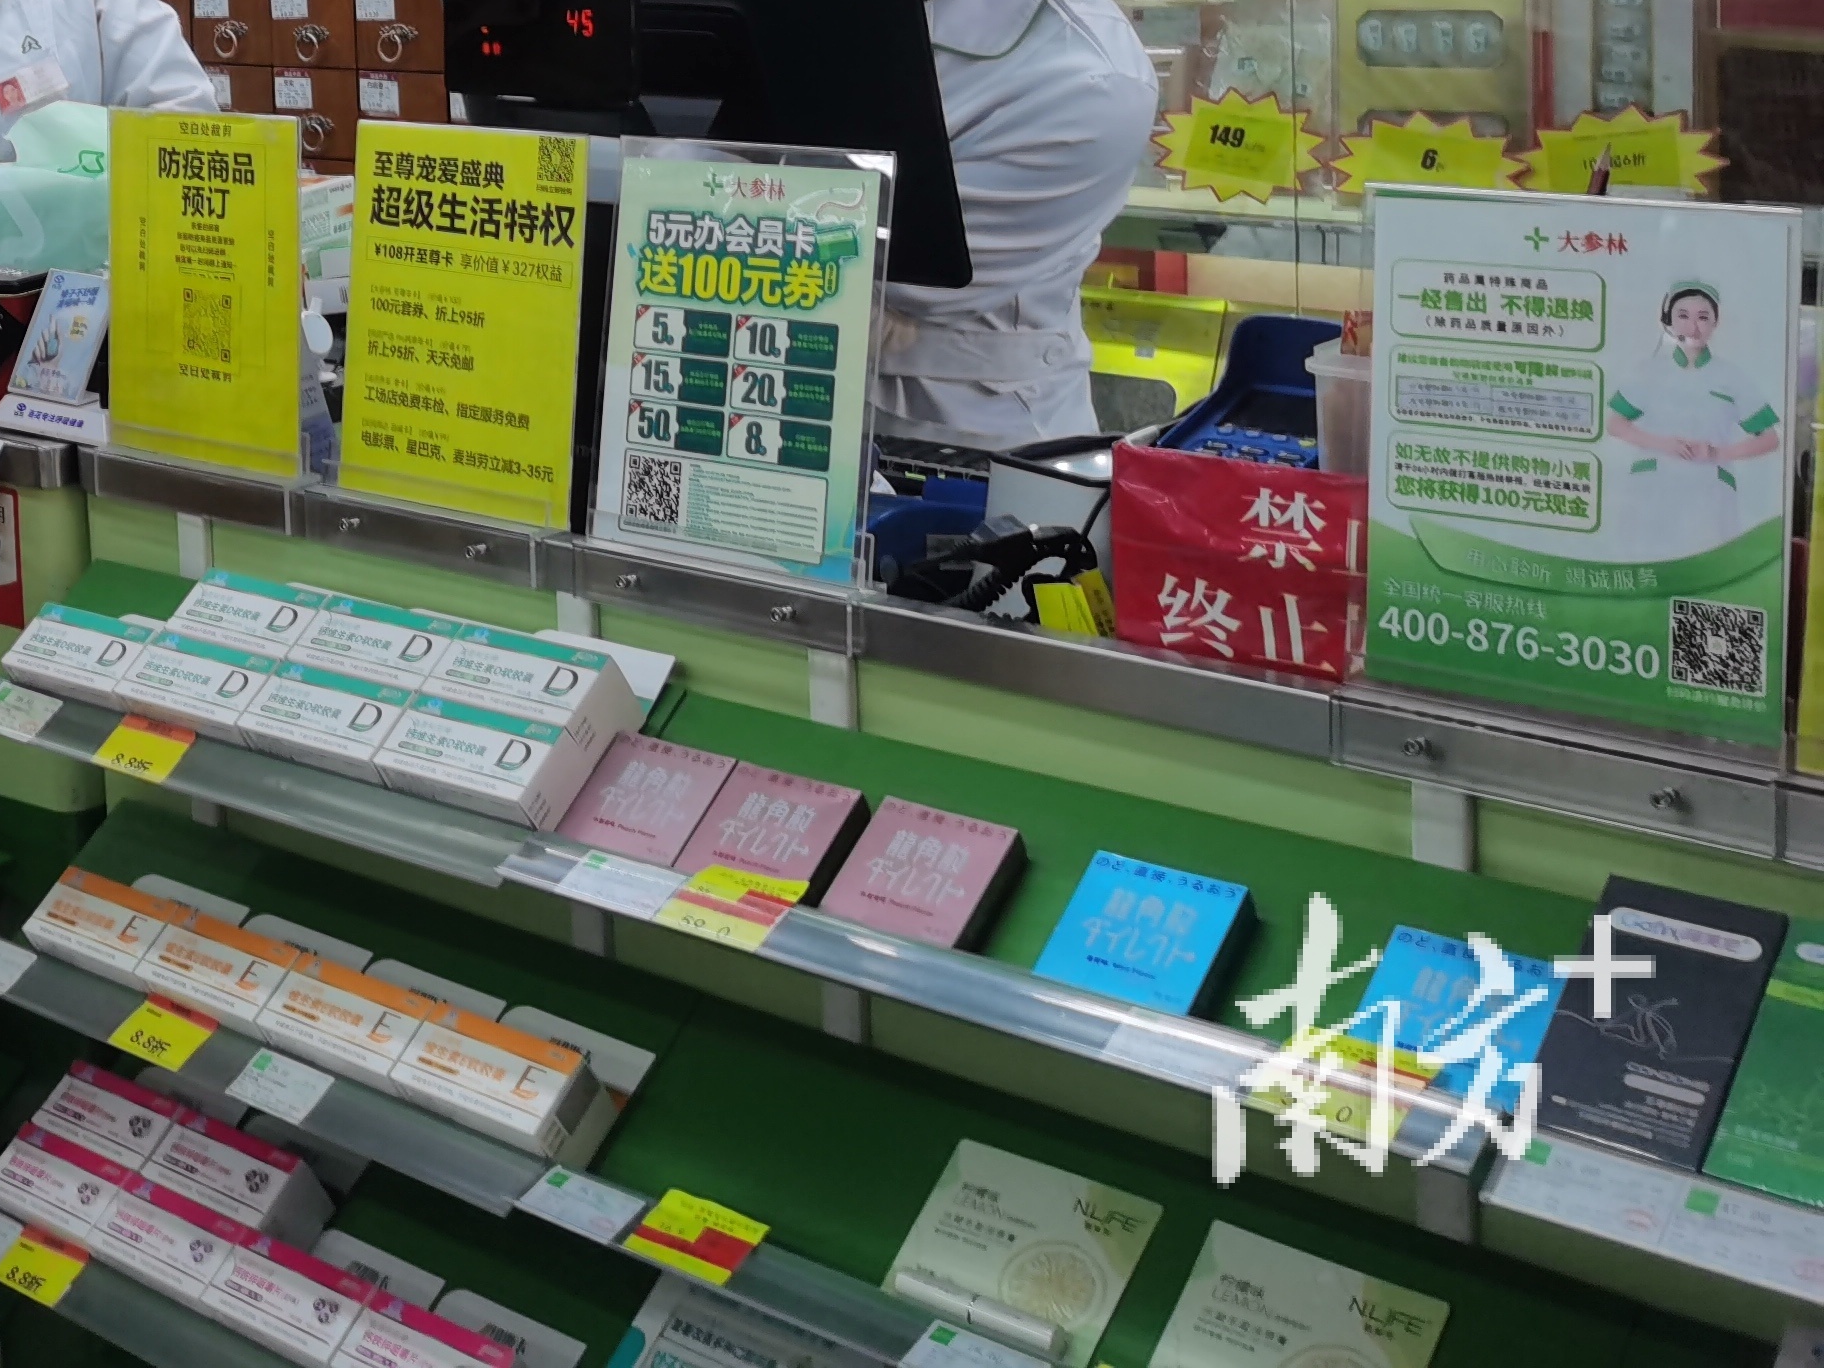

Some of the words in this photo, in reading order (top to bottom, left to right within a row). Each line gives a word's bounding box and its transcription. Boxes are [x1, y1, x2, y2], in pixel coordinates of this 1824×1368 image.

[565, 9, 594, 38] 45
[1209, 124, 1245, 148] 149
[158, 146, 255, 186] 防疫商品
[373, 150, 505, 190] 至尊宠爱盛典
[181, 185, 230, 220] 预订
[369, 184, 575, 249] 超级生活特权
[648, 212, 817, 259] 5元办会员卡
[374, 243, 454, 267] ¥108开至尊卡
[638, 246, 825, 309] 送100元券
[1398, 287, 1487, 314] 一经售出
[1500, 293, 1594, 322] 不得退换
[1395, 442, 1590, 481] 如无故不提供购物小票
[1395, 475, 1589, 518] 您将获得100元现金
[1383, 577, 1548, 620] 全国统一客服热线
[265, 605, 298, 633] D
[96, 640, 126, 667] D
[397, 634, 433, 662] D
[1379, 605, 1660, 680] 400-876-3030
[215, 670, 248, 698] D
[542, 666, 579, 696] D
[348, 702, 382, 731] D
[495, 739, 531, 770] D
